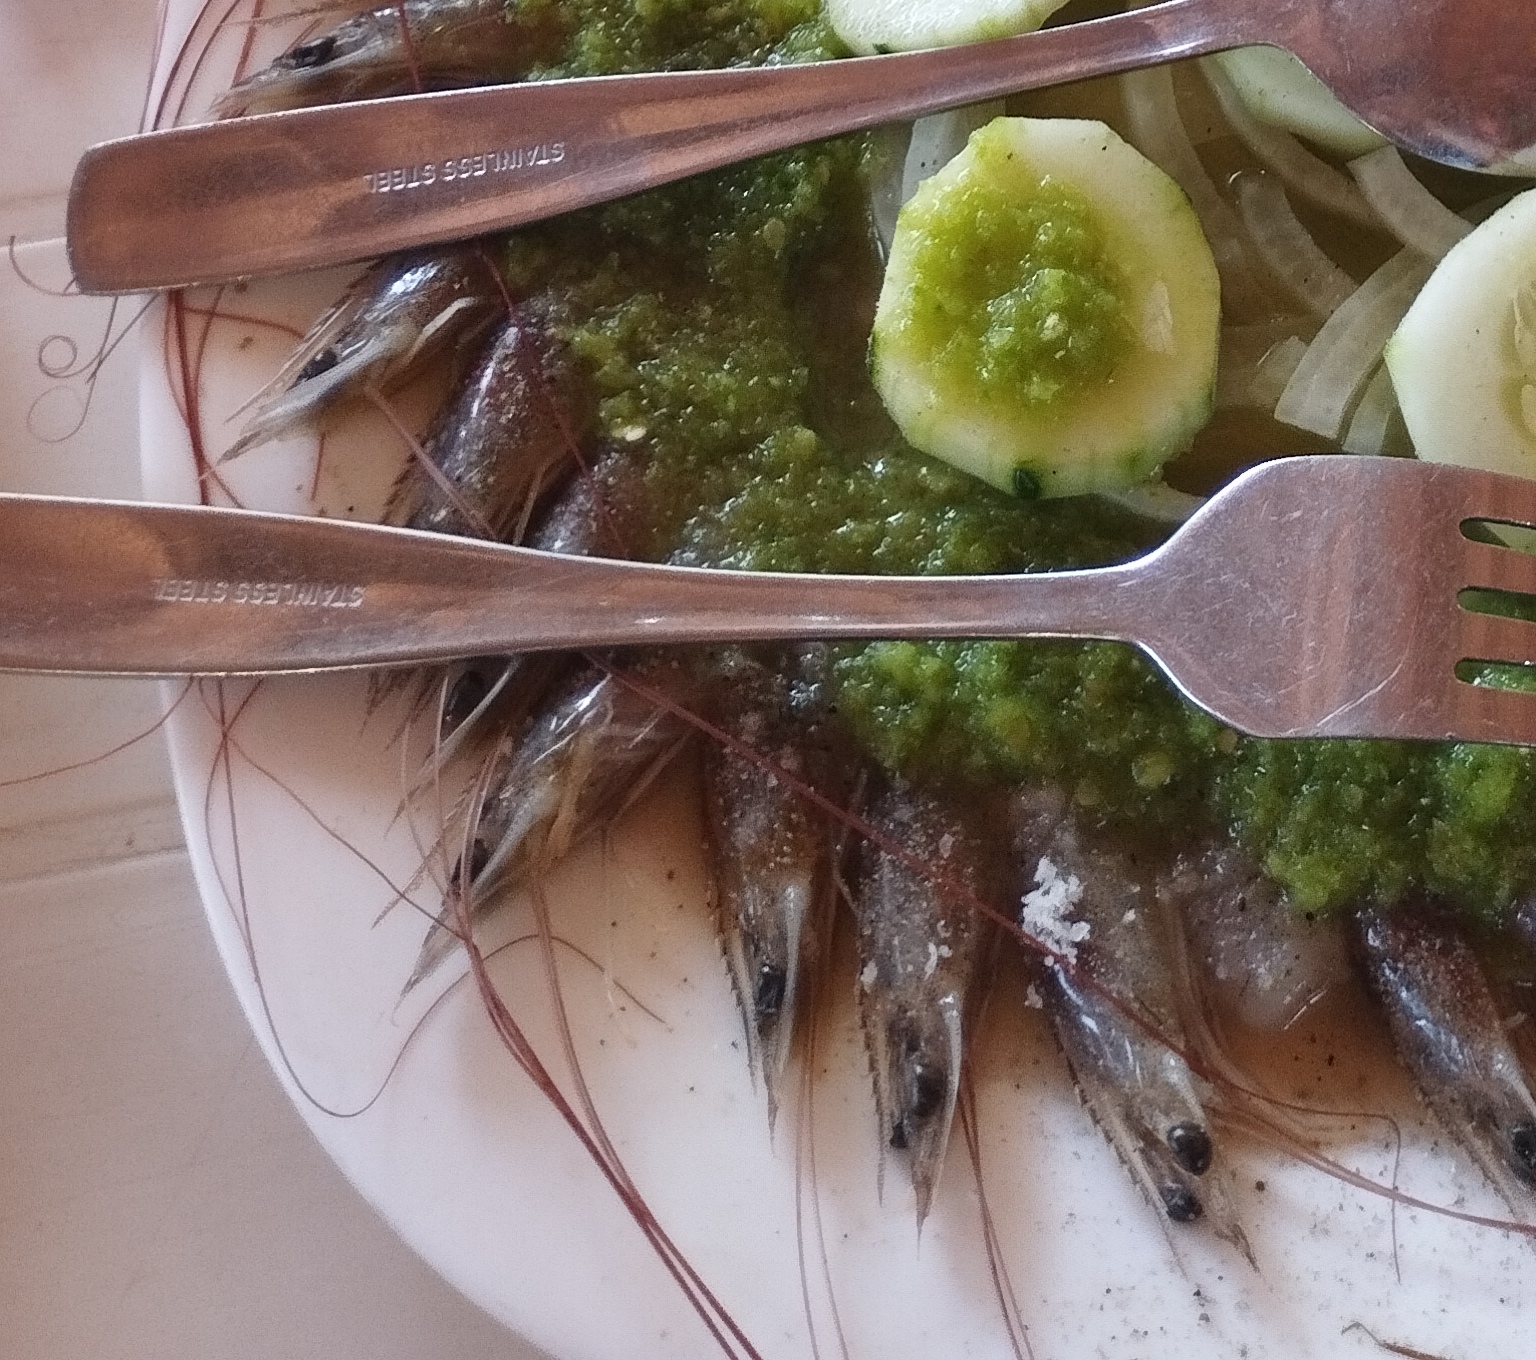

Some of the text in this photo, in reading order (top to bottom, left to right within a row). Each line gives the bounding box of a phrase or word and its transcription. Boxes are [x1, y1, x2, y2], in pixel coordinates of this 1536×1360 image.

[363, 141, 566, 194] STAINLESS STEEL
[231, 581, 366, 608] STAINLESS
